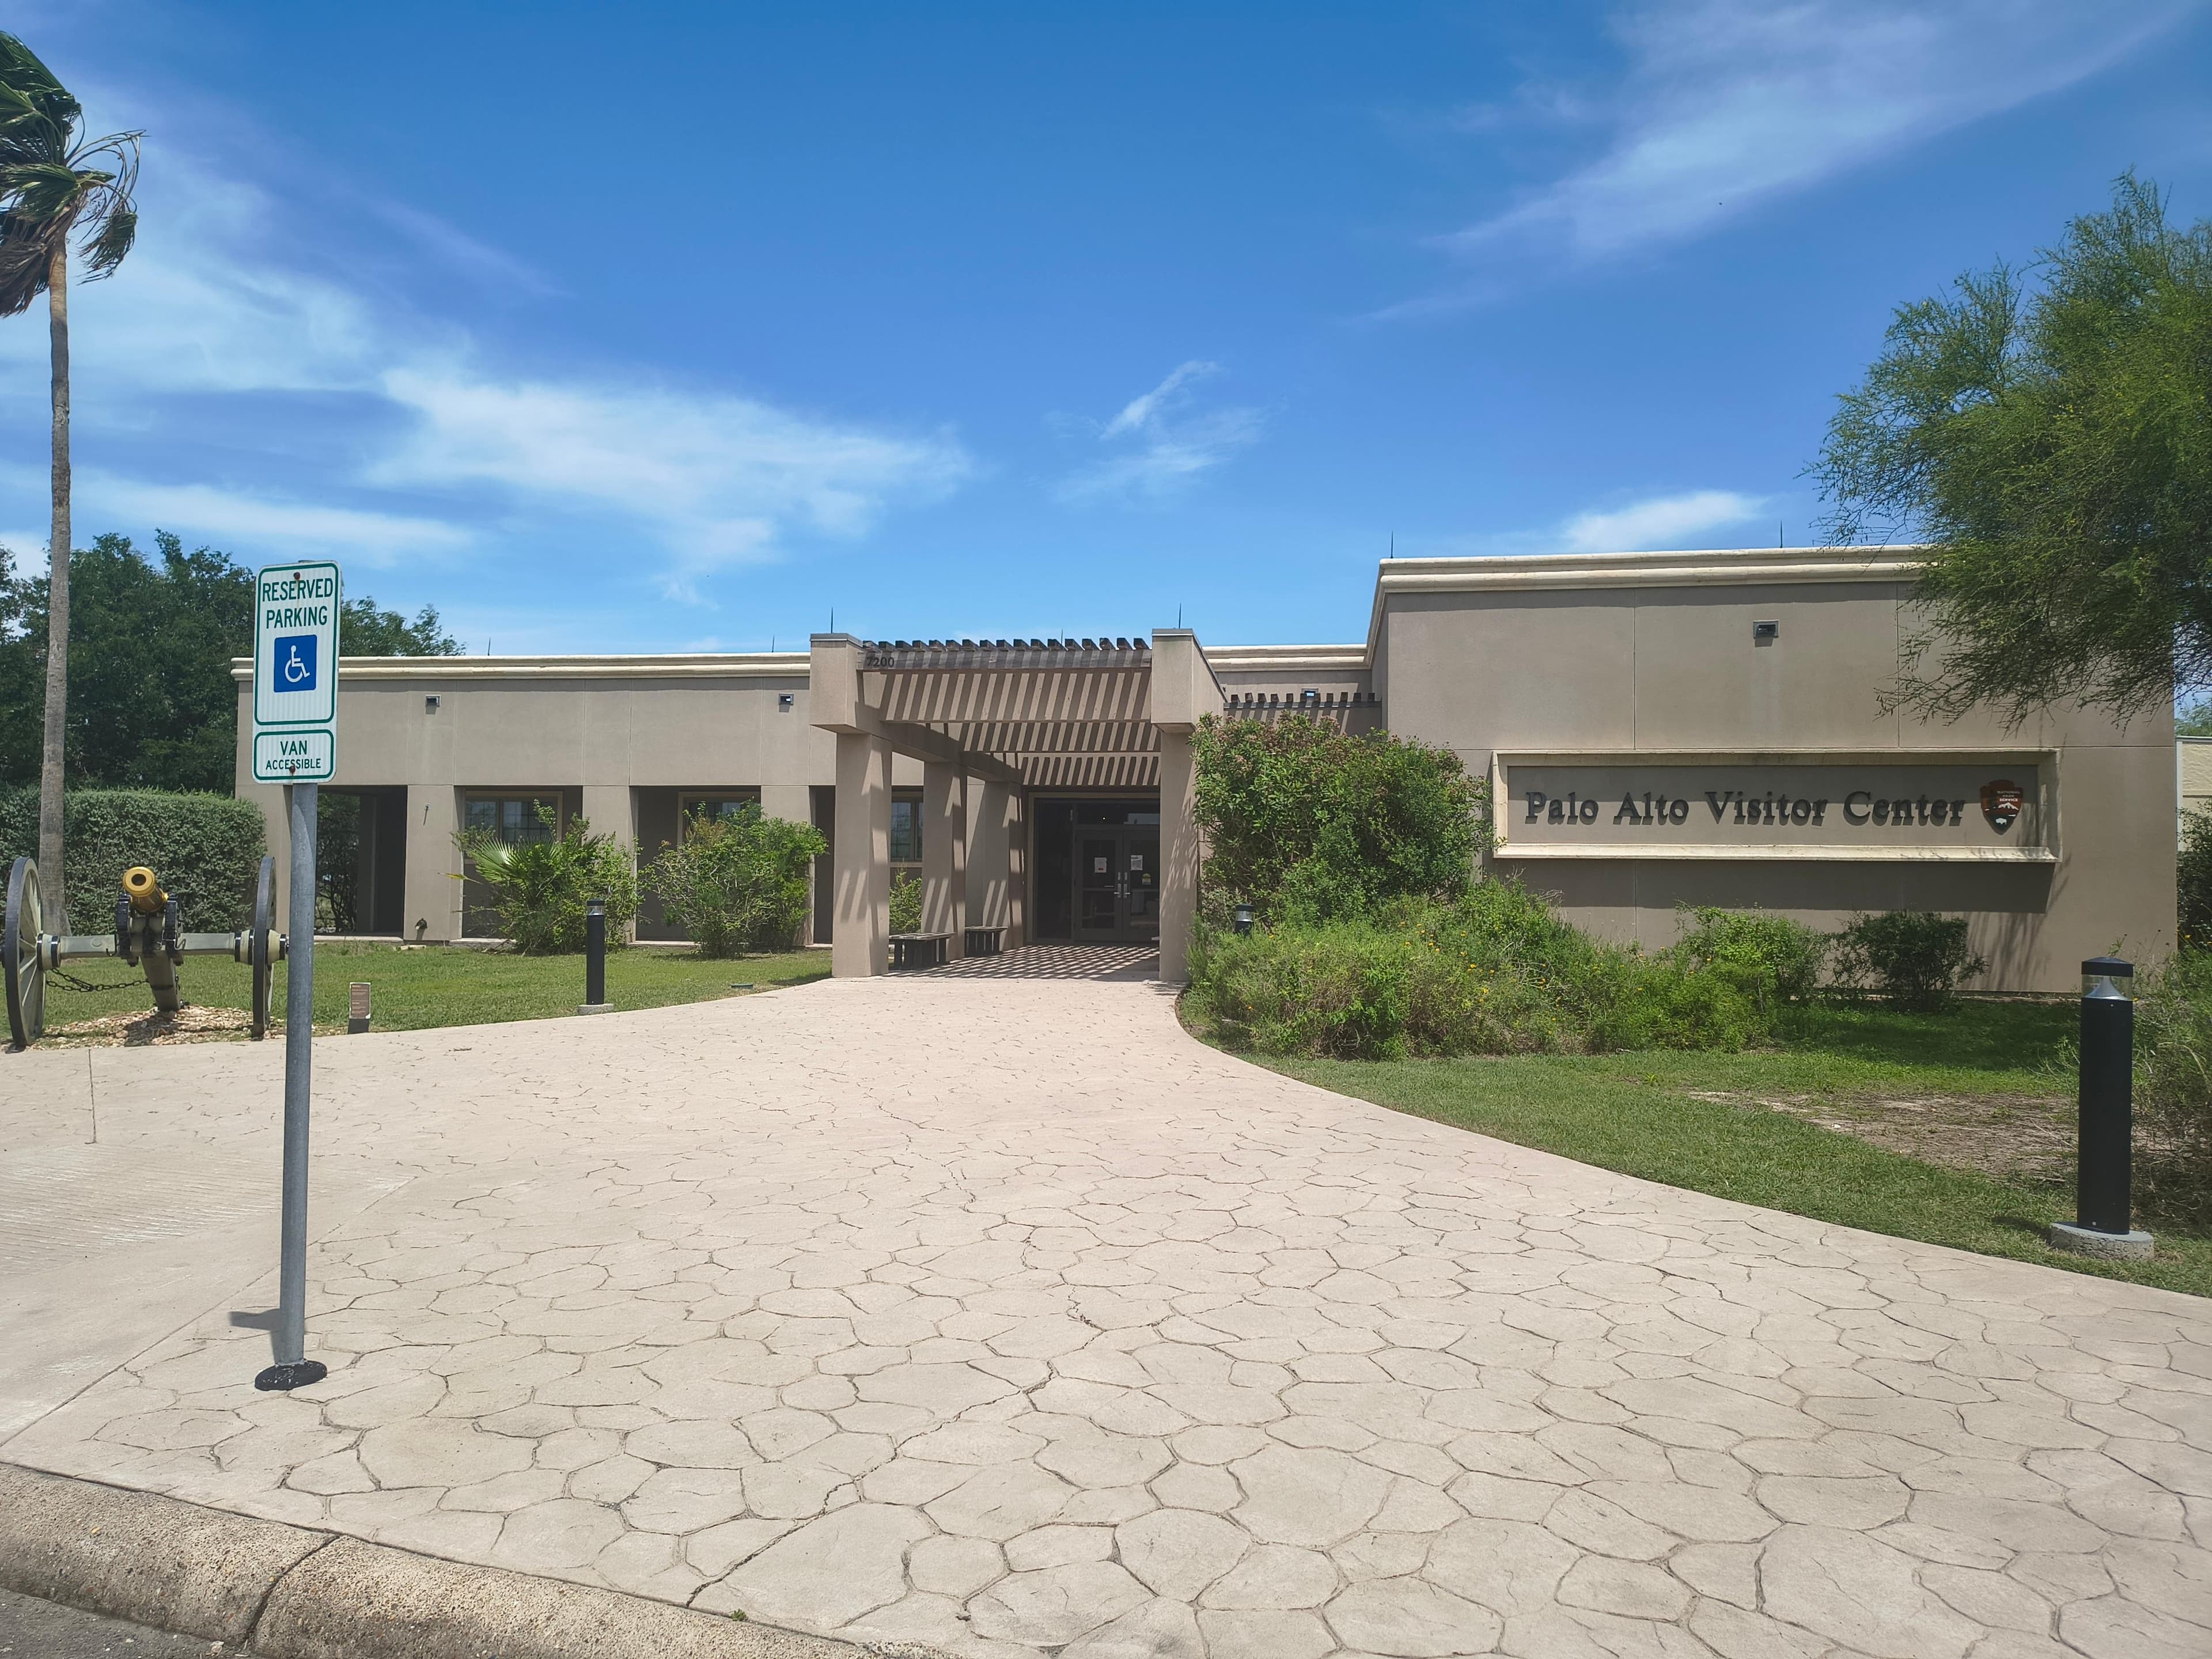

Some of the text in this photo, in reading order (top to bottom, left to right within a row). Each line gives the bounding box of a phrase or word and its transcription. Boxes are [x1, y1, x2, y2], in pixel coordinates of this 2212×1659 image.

[262, 578, 334, 602] RESERVED
[266, 605, 328, 629] PARKING
[866, 657, 895, 667] 7200
[280, 740, 308, 756] VAN
[266, 759, 321, 770] ACCESSIBLE
[1525, 790, 1966, 820] Palo Alto Visitor Center
